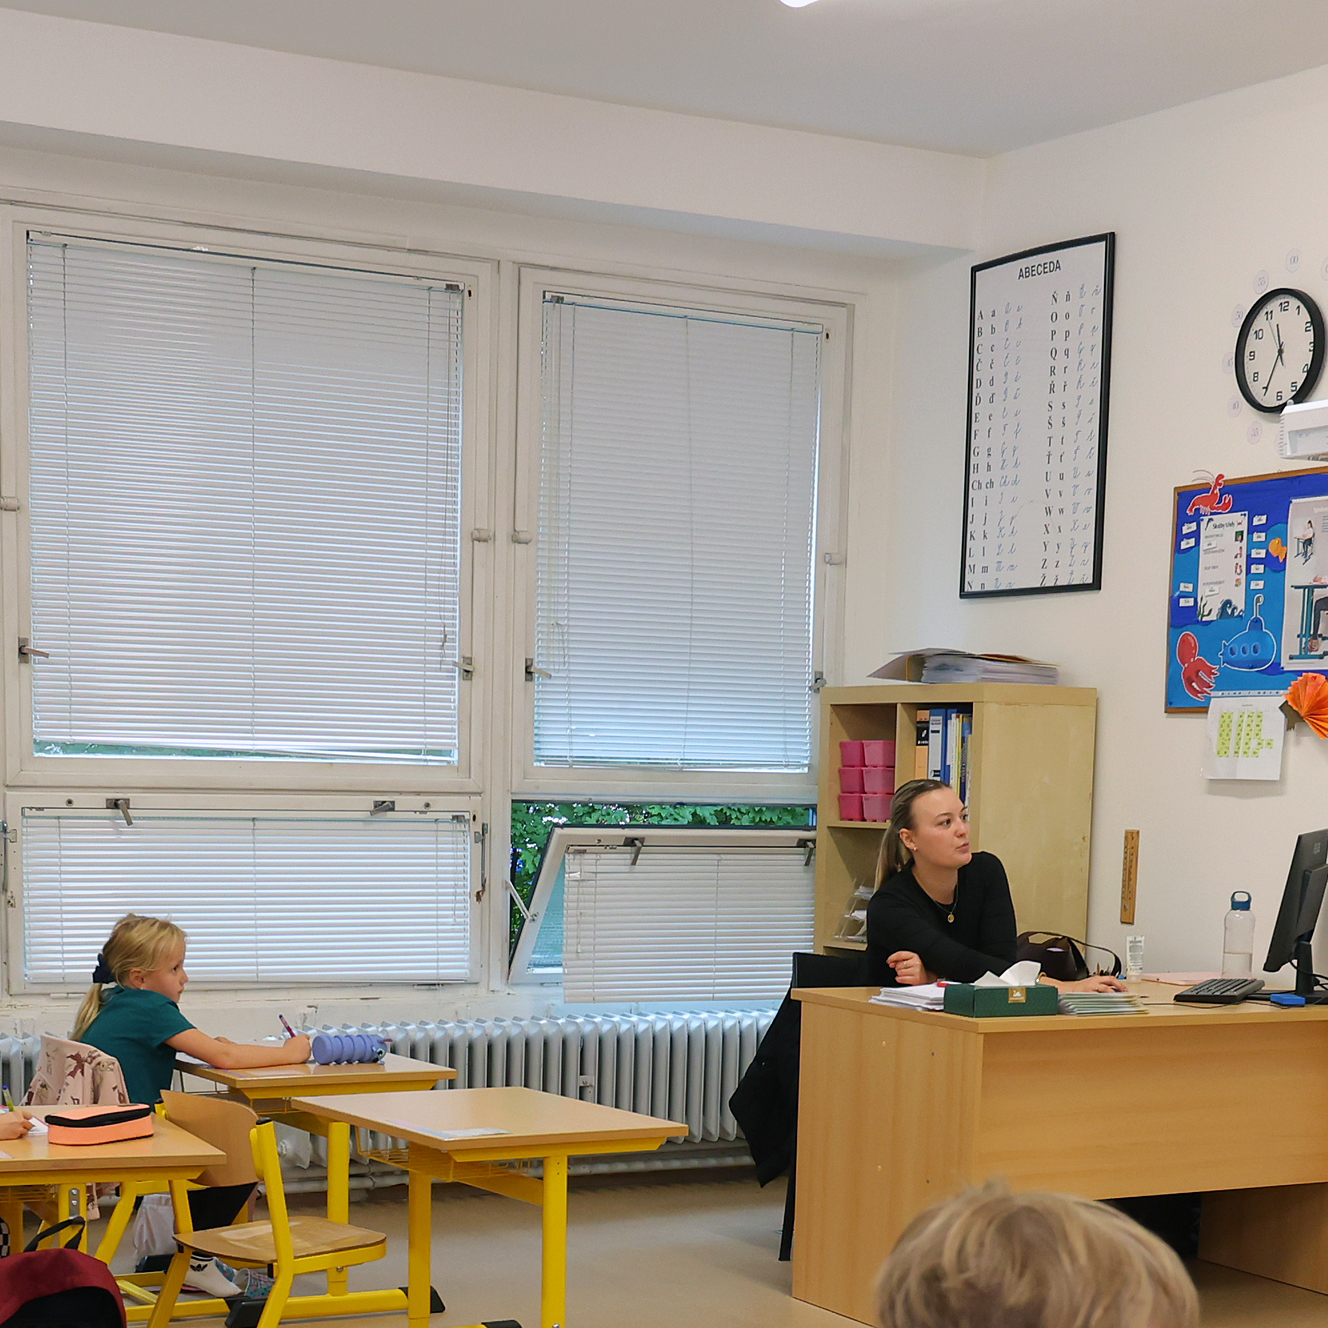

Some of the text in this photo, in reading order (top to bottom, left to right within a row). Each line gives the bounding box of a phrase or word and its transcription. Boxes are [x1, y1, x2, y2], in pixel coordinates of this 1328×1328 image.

[1018, 260, 1061, 280] ABECEDA
[1051, 291, 1070, 305] Ň ň
[1279, 301, 1290, 312] 12
[1296, 306, 1301, 315] 1
[978, 309, 995, 320] A a
[1051, 312, 1069, 322] O o
[1265, 310, 1273, 320] 11
[978, 325, 995, 337] B b
[1305, 321, 1313, 332] 2
[1051, 330, 1070, 341] P p
[1254, 329, 1263, 340] 10
[977, 344, 983, 354] C
[1309, 342, 1314, 352] 3
[1051, 348, 1069, 360] Q q
[1249, 351, 1255, 360] 9
[976, 359, 982, 371] Č
[1302, 364, 1309, 374] 4
[1050, 366, 1056, 376] R
[976, 376, 994, 389] D d
[1253, 372, 1259, 382] 8
[1049, 381, 1067, 394] Ř ř
[1262, 387, 1268, 396] 7
[1291, 382, 1297, 392] 5
[975, 393, 995, 406] Ď ď
[1276, 391, 1282, 401] 6
[1048, 401, 1066, 412] S s
[975, 412, 992, 423] E e
[1048, 416, 1065, 429] Š š
[974, 428, 992, 440] F f
[1047, 436, 1053, 447] T
[973, 447, 991, 458] G g
[973, 462, 991, 473] H h
[1045, 471, 1064, 482] U u
[972, 478, 994, 490] Ch ch
[1045, 489, 1063, 499] V v
[1045, 506, 1053, 516] W
[970, 514, 974, 524] J
[1044, 523, 1062, 534] X x
[970, 530, 988, 541] K k
[1043, 541, 1061, 553] Y y
[969, 548, 974, 558] L
[968, 564, 975, 574] M
[1041, 559, 1060, 569] Z z
[967, 581, 985, 590] N n
[1040, 574, 1059, 586] Ž ž
